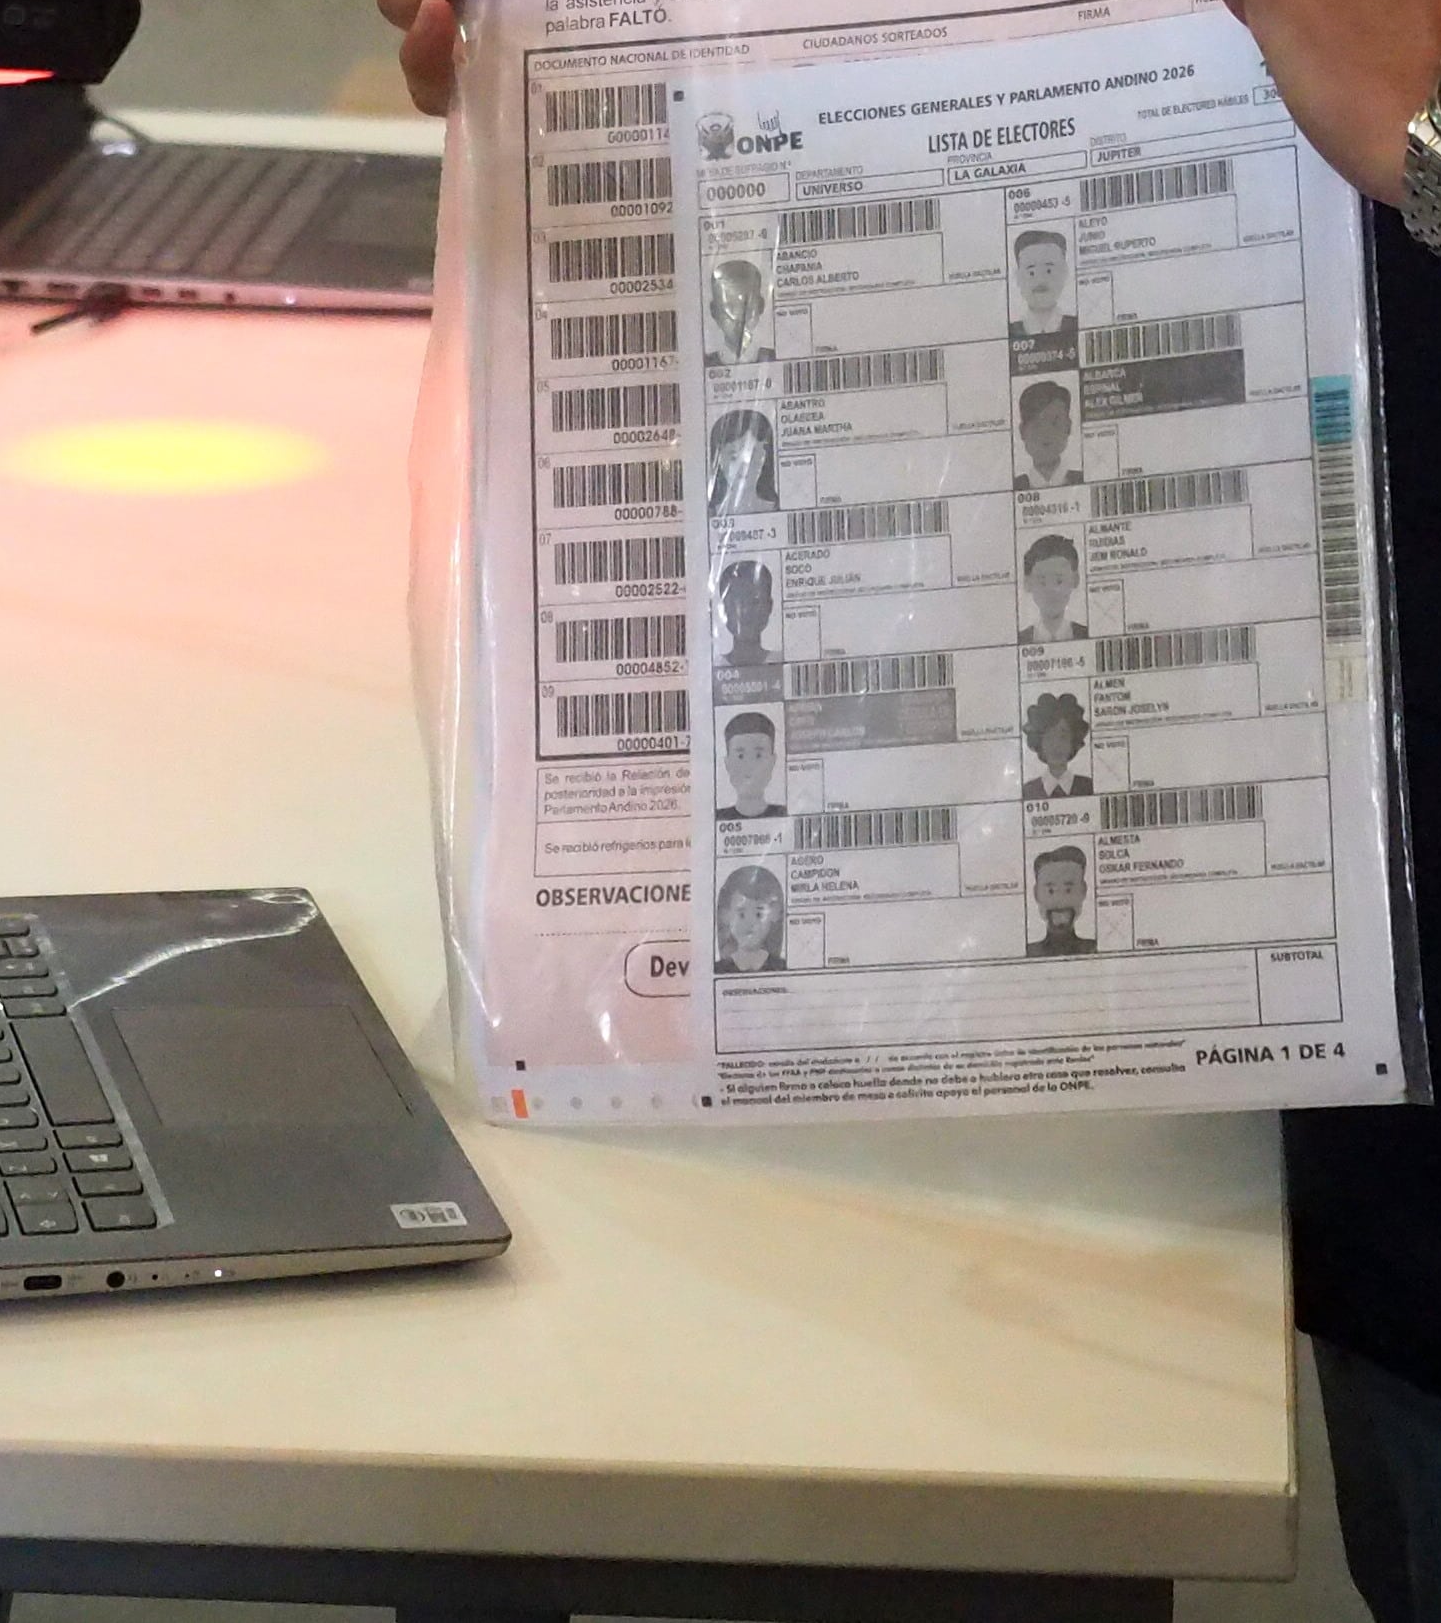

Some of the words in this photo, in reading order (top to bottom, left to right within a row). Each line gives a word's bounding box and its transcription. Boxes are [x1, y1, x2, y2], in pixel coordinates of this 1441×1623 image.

[545, 14, 606, 37] palabra
[608, 4, 673, 28] FALTÓ.
[1077, 6, 1112, 22] FIRMA
[802, 33, 880, 51] CIUDADANOS
[881, 26, 948, 44] SORTEADOS
[533, 56, 608, 73] DOCUMENTO
[610, 50, 669, 66] NACIONAL
[670, 47, 687, 60] DE
[689, 44, 750, 61] IDENTIDAD
[818, 105, 906, 126] ELECCIONES
[910, 97, 992, 117] GENERALES
[996, 91, 1006, 106] Y
[1008, 79, 1101, 105] PARLAMENTO
[1104, 70, 1159, 91] ANDINO
[1162, 64, 1195, 82] 2026
[736, 130, 804, 155] ONPE
[927, 131, 968, 154] LISTA
[972, 127, 993, 149] DE
[996, 116, 1077, 146] ELECTORES
[1096, 146, 1142, 163] JUPITER
[954, 168, 971, 181] LA
[973, 163, 1027, 179] GALAXIA
[707, 182, 766, 202] 000000
[802, 181, 863, 197] UNIVERSO
[1026, 802, 1049, 814] 010
[1270, 950, 1324, 963] SUBTOTAL
[1195, 1043, 1275, 1067] PÁGINA
[1281, 1045, 1291, 1062] 1
[1299, 1042, 1328, 1061] DE
[1332, 1041, 1346, 1059] 4
